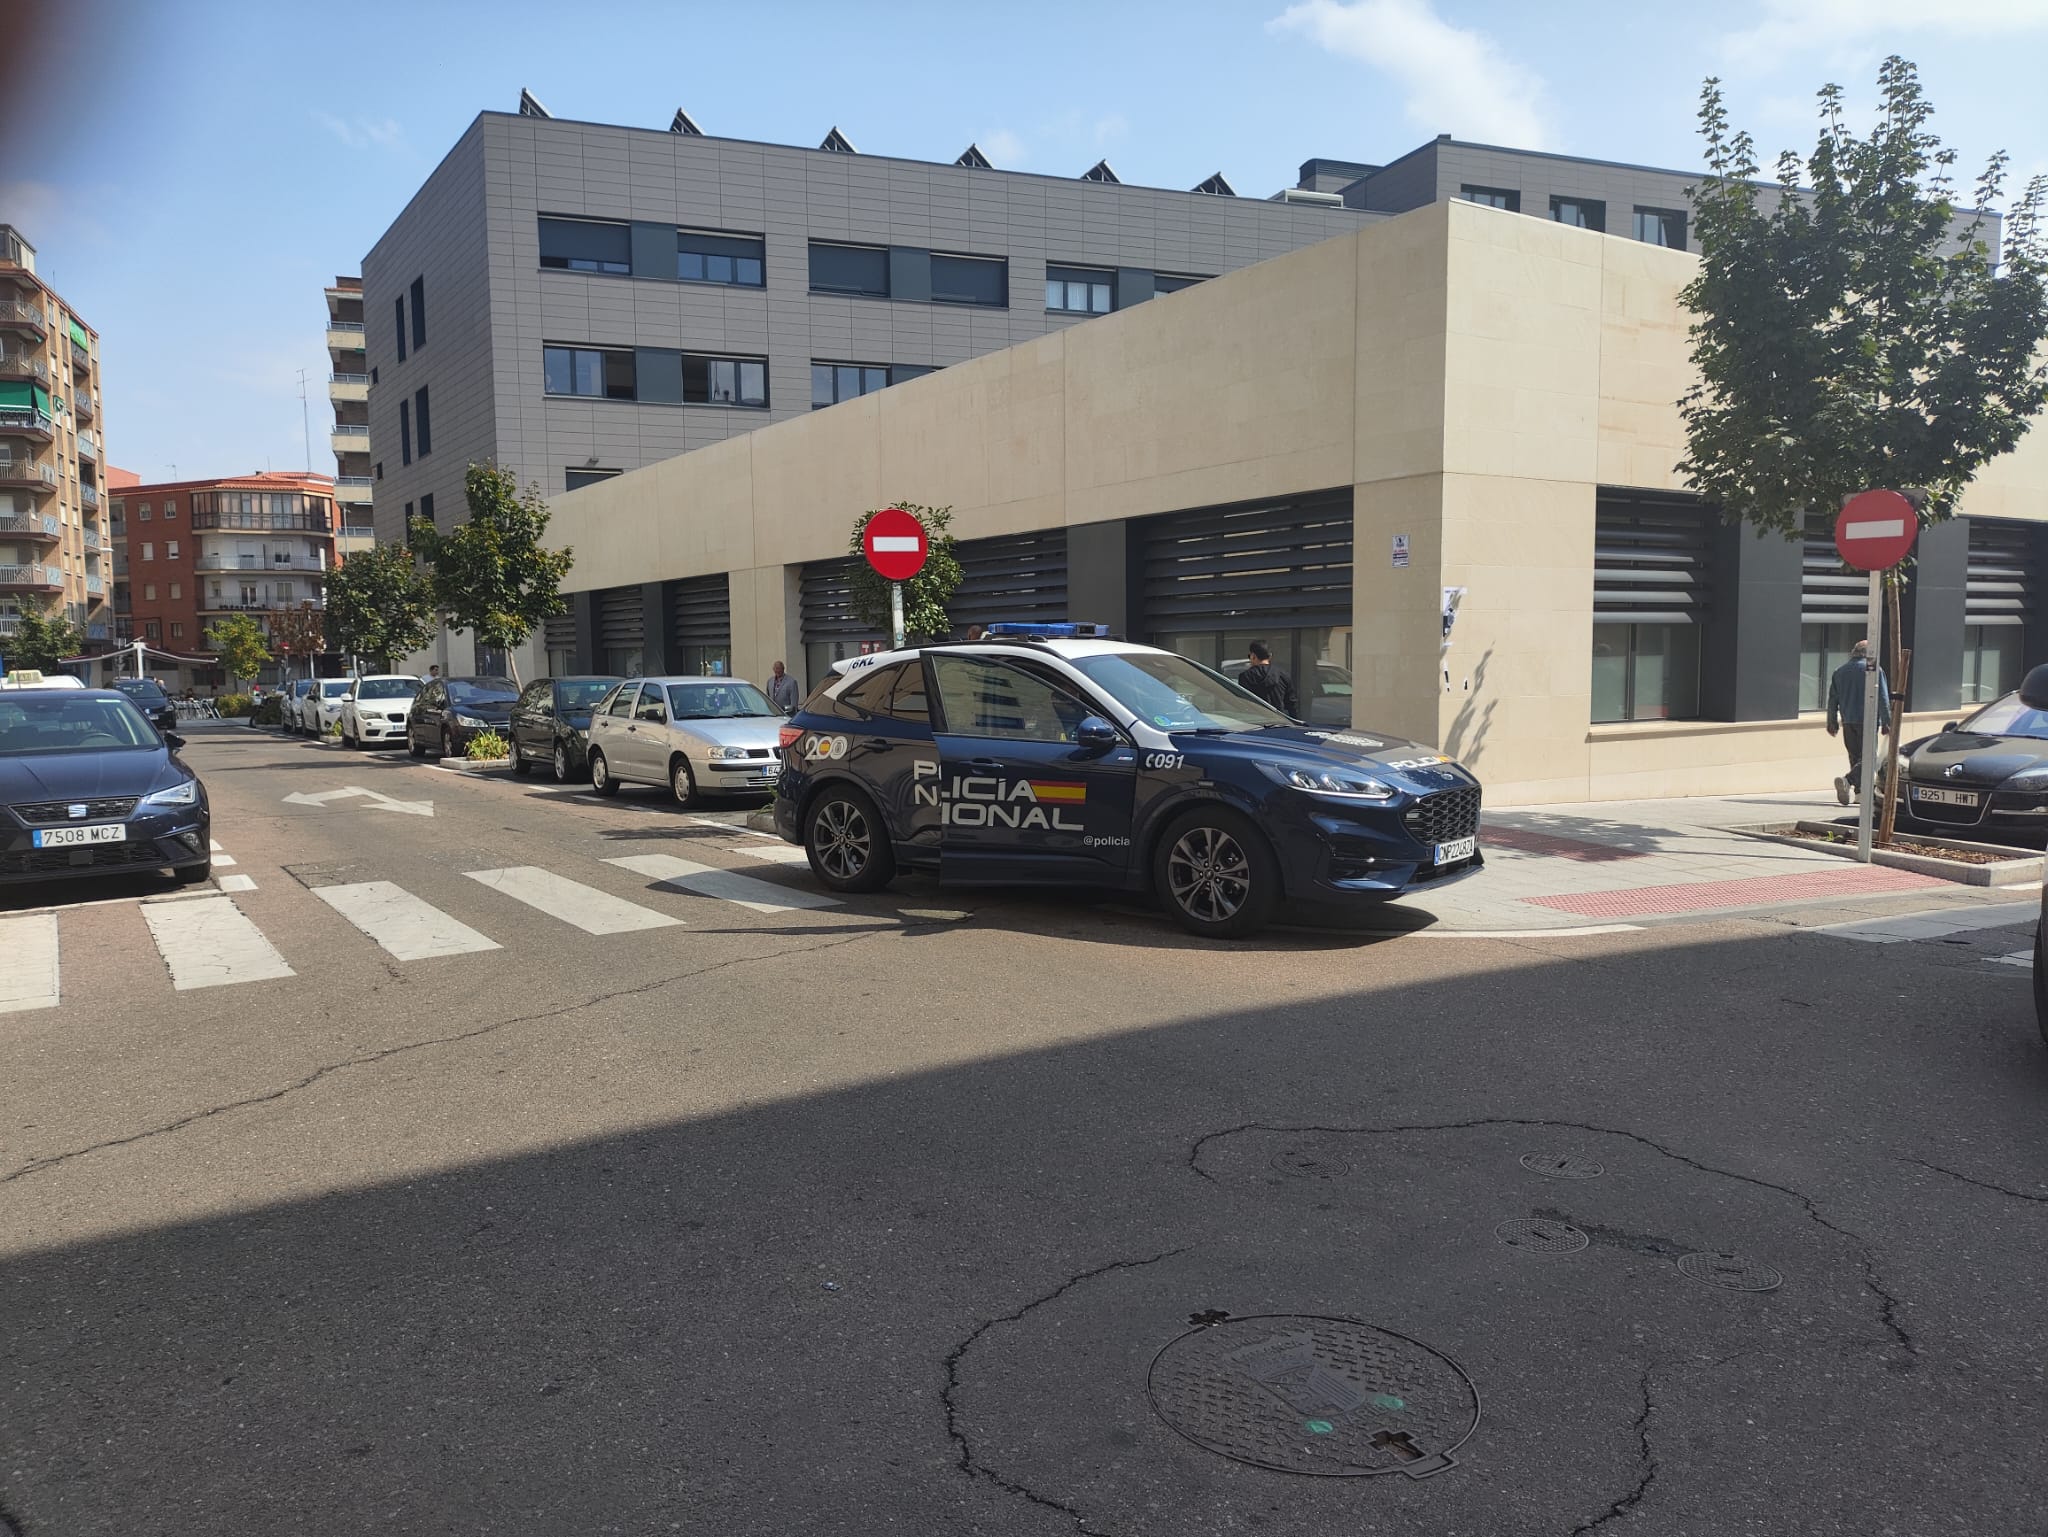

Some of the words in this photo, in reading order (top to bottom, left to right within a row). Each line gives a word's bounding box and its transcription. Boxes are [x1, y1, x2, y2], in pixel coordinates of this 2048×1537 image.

[1154, 753, 1185, 769] 091
[1920, 788, 1946, 801] 9251
[1955, 793, 1976, 805] HWT
[914, 783, 1085, 831] NIONAL
[44, 829, 85, 845] 7508
[90, 826, 120, 841] MCZ
[1083, 835, 1131, 848] @policia
